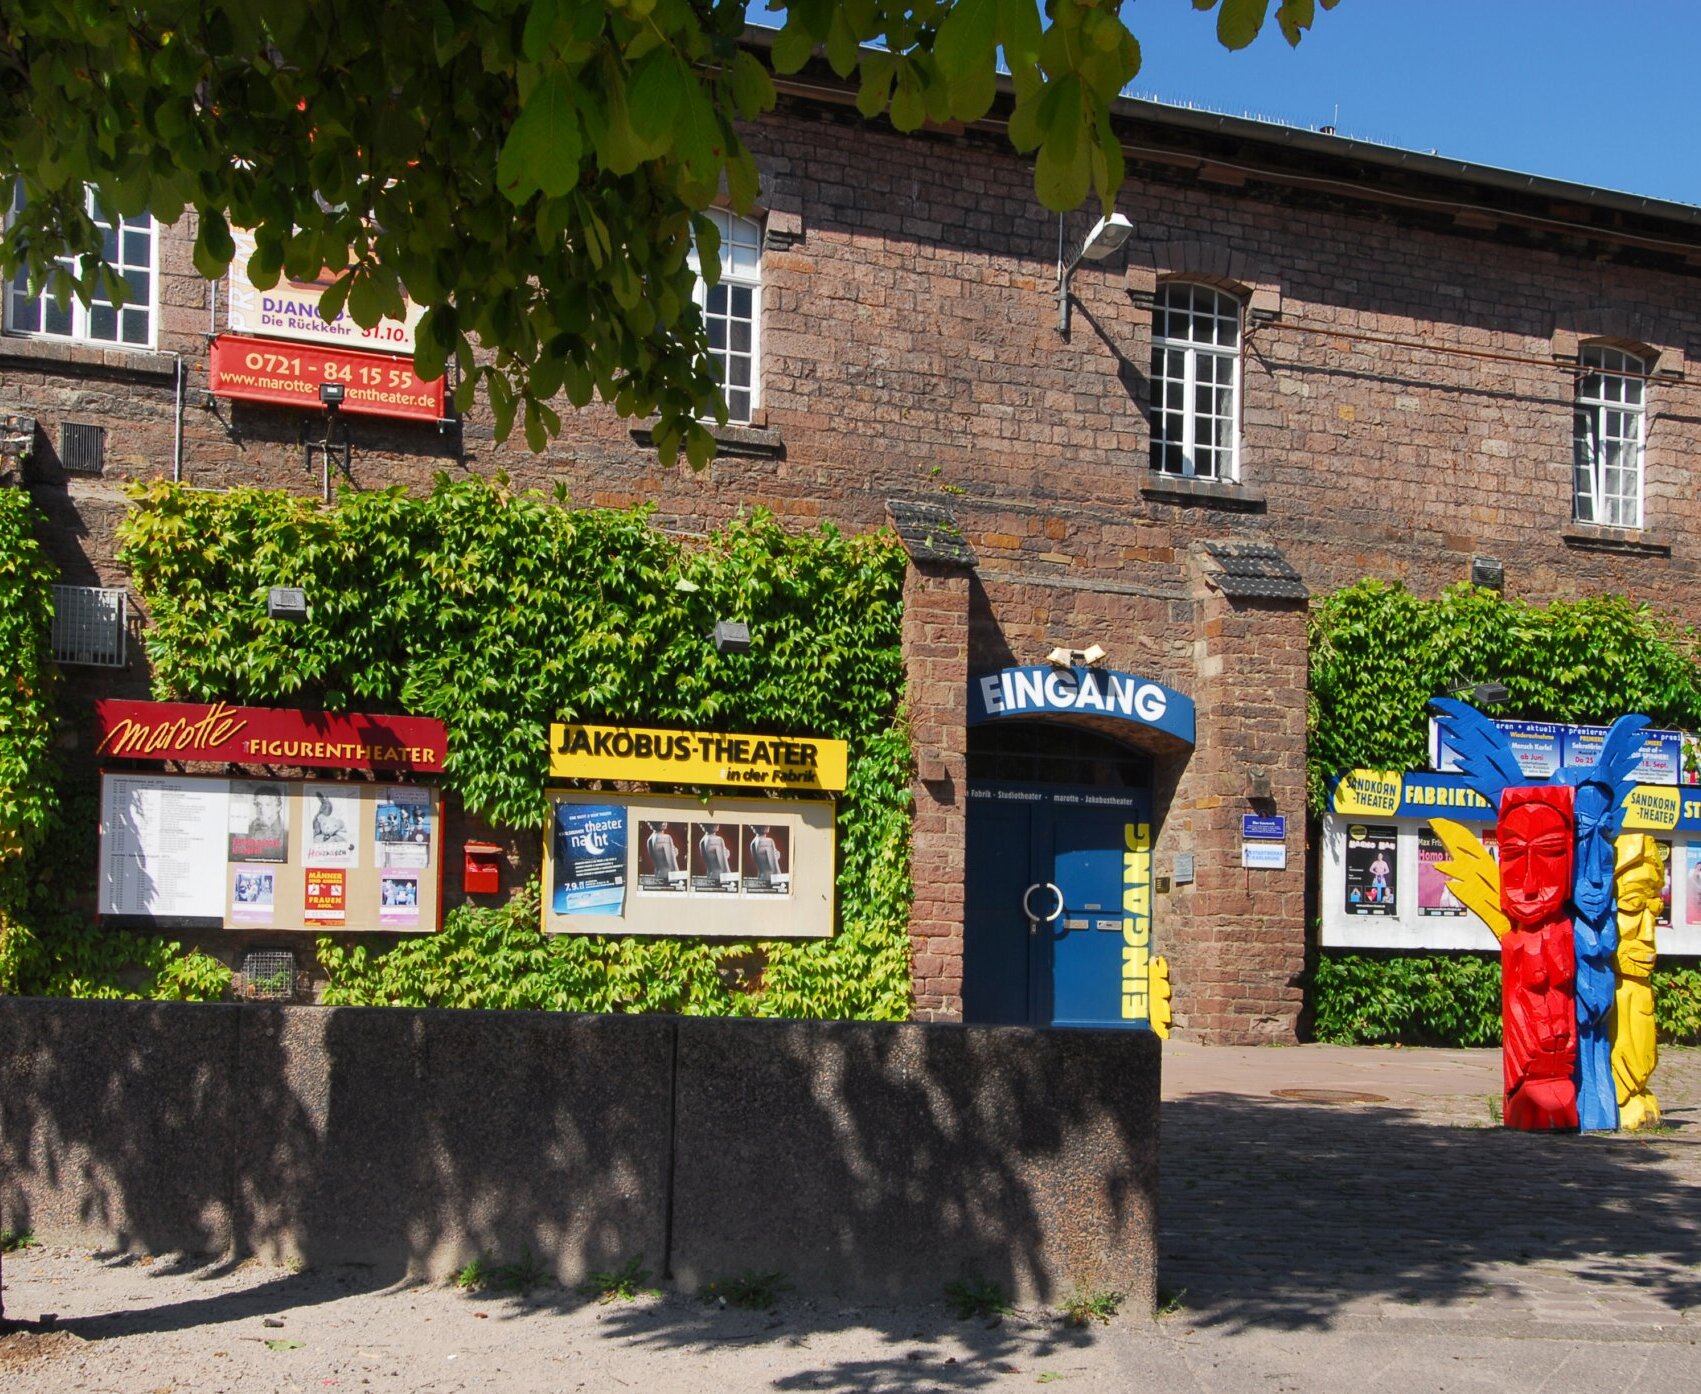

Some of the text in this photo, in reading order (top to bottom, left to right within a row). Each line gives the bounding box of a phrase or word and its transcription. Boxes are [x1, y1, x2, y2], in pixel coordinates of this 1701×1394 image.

[261, 314, 351, 335] Die Rückkehr
[245, 352, 302, 376] 0721
[323, 361, 353, 383] 84
[359, 368, 382, 386] 15
[388, 370, 413, 389] 55
[219, 371, 436, 409] www.marotte-rentheater.de
[979, 669, 1168, 722] EINGANG
[1526, 724, 1556, 733] aktuell
[249, 738, 436, 764] FIGURENTHEATER
[557, 727, 819, 768] JAKOBUS-THEATER
[1531, 753, 1544, 761] Juni
[726, 766, 817, 784] in der Fabrik
[997, 790, 1042, 801] Studiotheater
[1053, 794, 1080, 802] marotte
[1346, 777, 1396, 797] SANDKORN
[1405, 785, 1492, 808] FABRIKTH
[1353, 791, 1395, 811] -THEATER
[1630, 792, 1677, 811] SANDKORN
[1636, 807, 1675, 824] -THEATER
[584, 819, 622, 833] theater
[1418, 838, 1430, 846] Max
[1419, 849, 1444, 860] Homo
[308, 896, 342, 904] FRAUEN
[1121, 822, 1151, 1020] EINGANG
